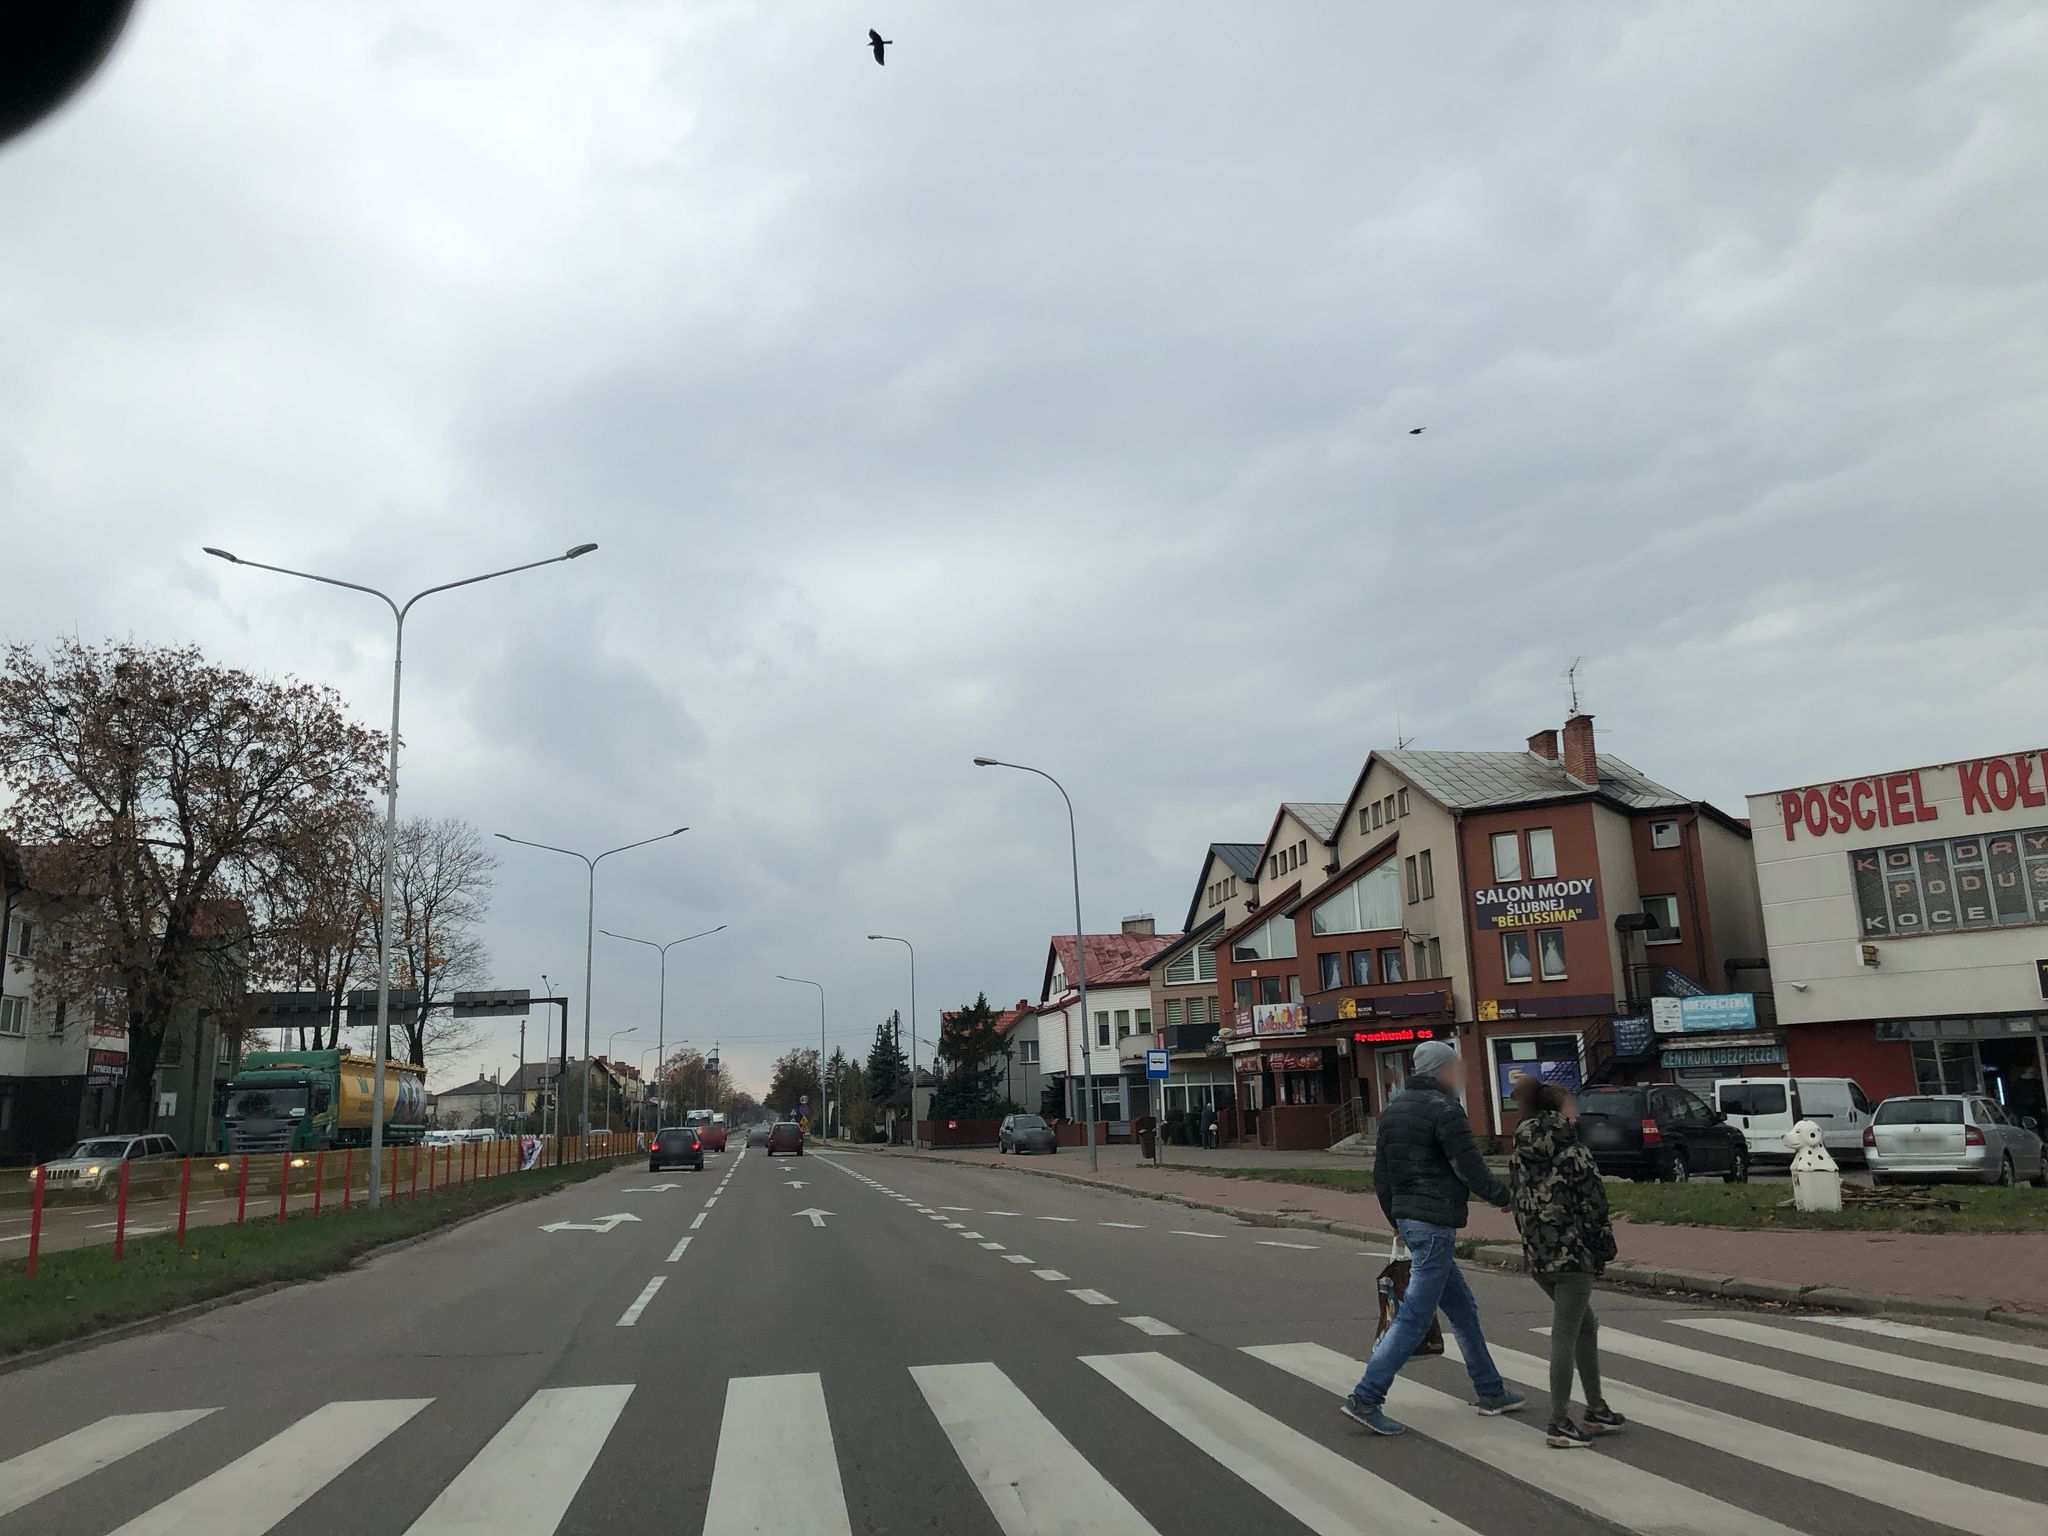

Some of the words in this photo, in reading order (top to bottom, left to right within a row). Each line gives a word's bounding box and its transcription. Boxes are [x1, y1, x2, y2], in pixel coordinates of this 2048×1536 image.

[1475, 885, 1534, 905] SALON
[1538, 878, 1594, 899] MODY
[1506, 898, 1565, 915] ŚLUBNEJ
[1491, 908, 1583, 928] "BELLISSIMA"
[1866, 907, 1986, 930] KOCE
[1663, 1049, 1711, 1066] CENTRUM
